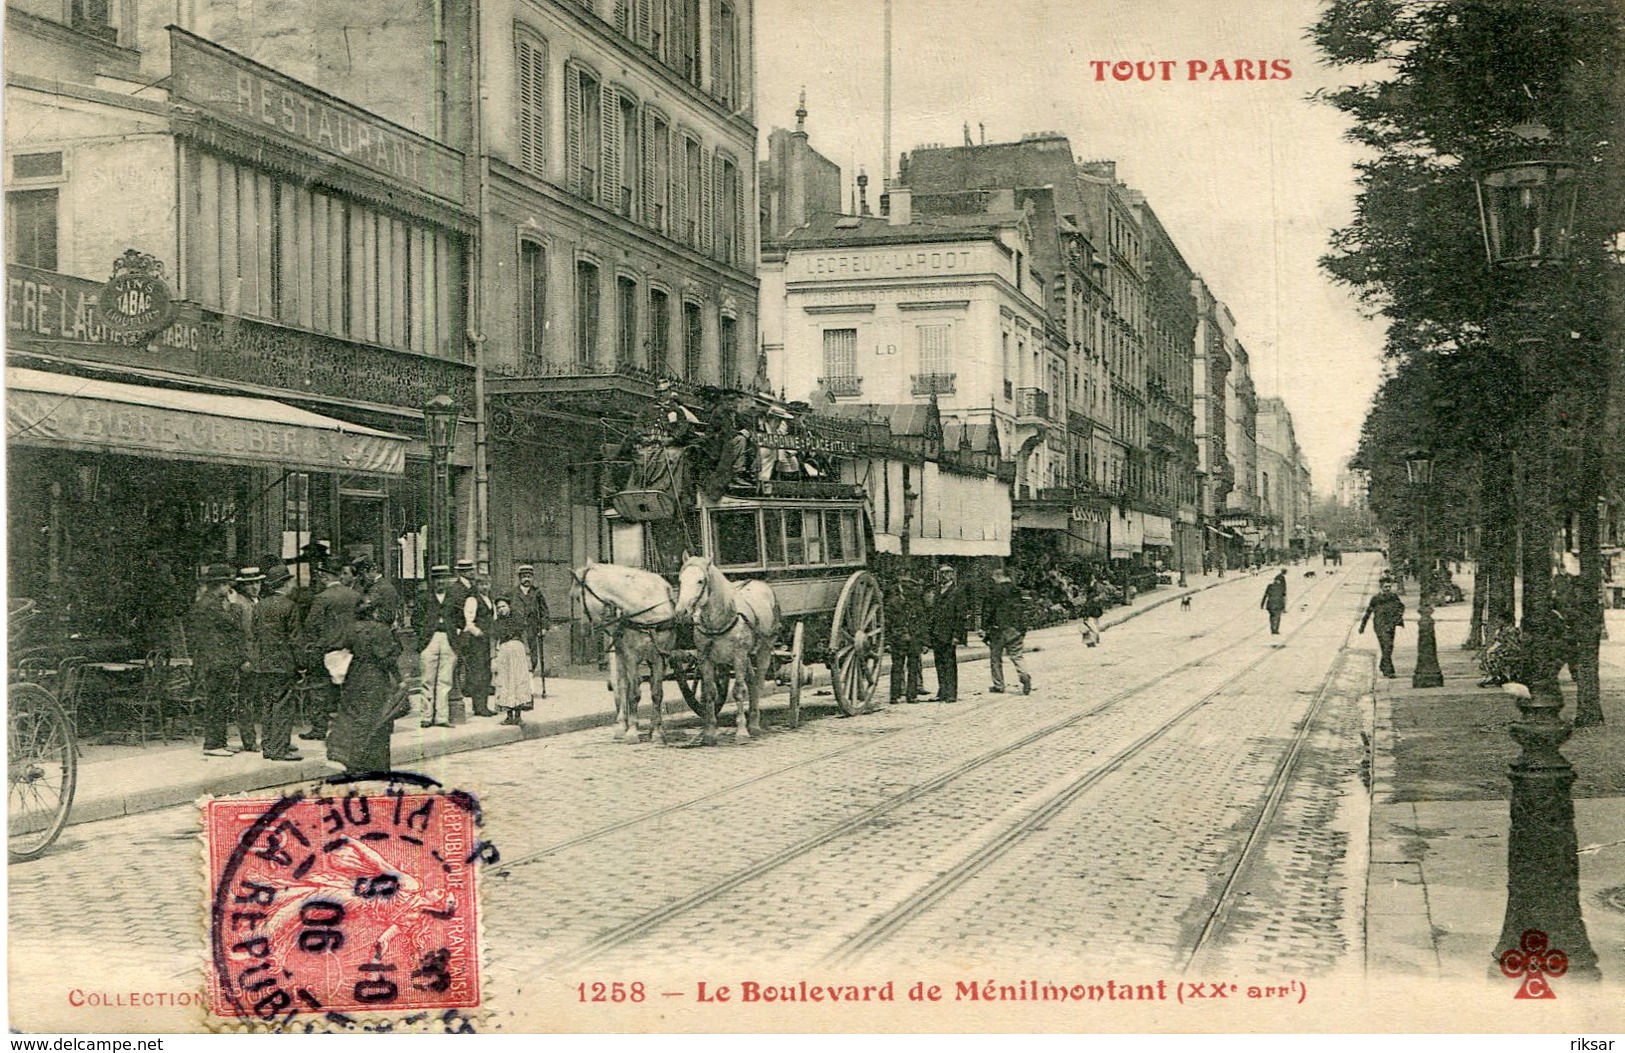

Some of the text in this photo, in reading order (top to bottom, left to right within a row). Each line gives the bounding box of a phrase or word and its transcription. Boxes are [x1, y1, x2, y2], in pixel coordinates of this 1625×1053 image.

[237, 74, 422, 182] RESTAURANT
[115, 278, 154, 293] VINS
[117, 289, 152, 316] TABAC
[162, 323, 200, 351] TABAC
[299, 900, 346, 955] 06
